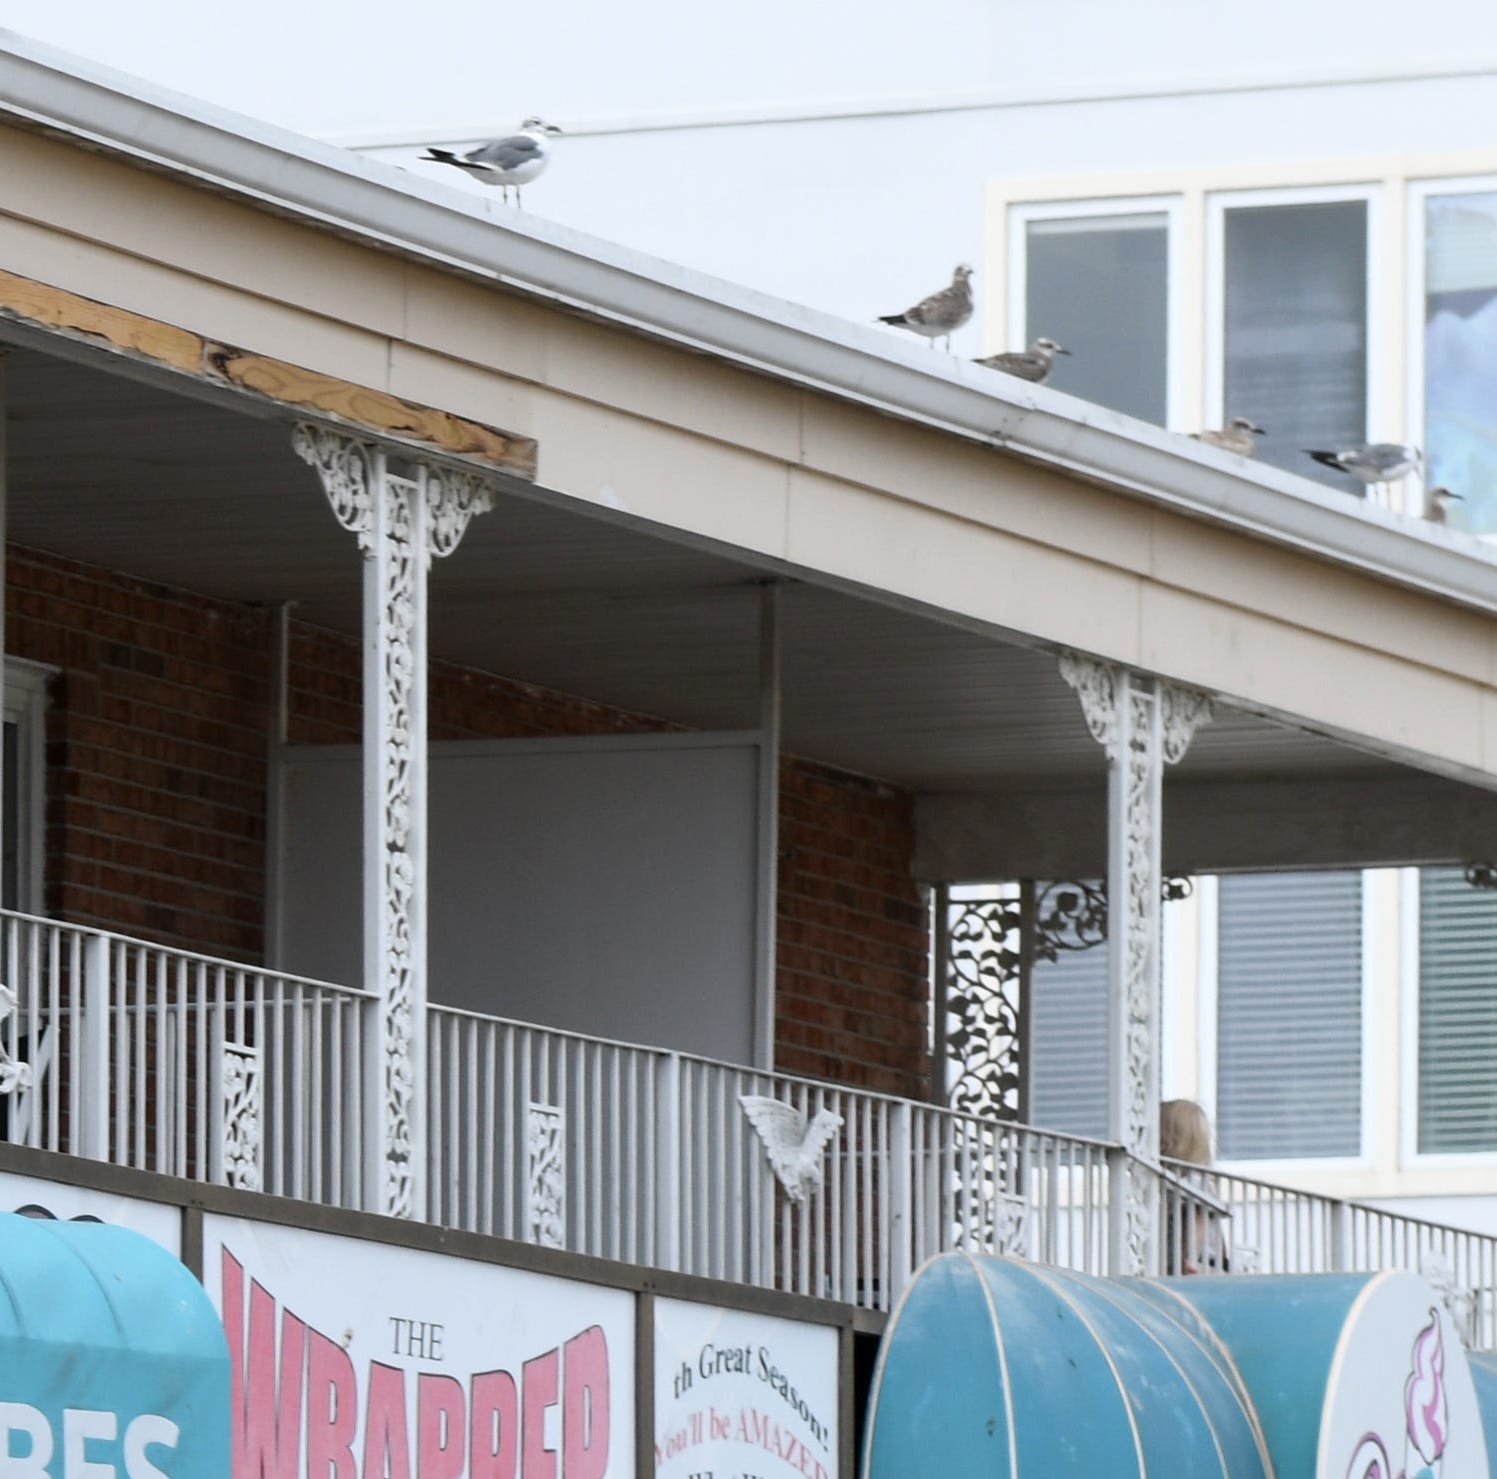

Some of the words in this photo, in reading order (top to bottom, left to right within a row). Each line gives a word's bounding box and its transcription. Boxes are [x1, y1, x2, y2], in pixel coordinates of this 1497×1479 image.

[389, 1317, 444, 1361] THE
[699, 1345, 751, 1379] Great
[757, 1347, 828, 1451] Season!
[710, 1407, 730, 1440] be
